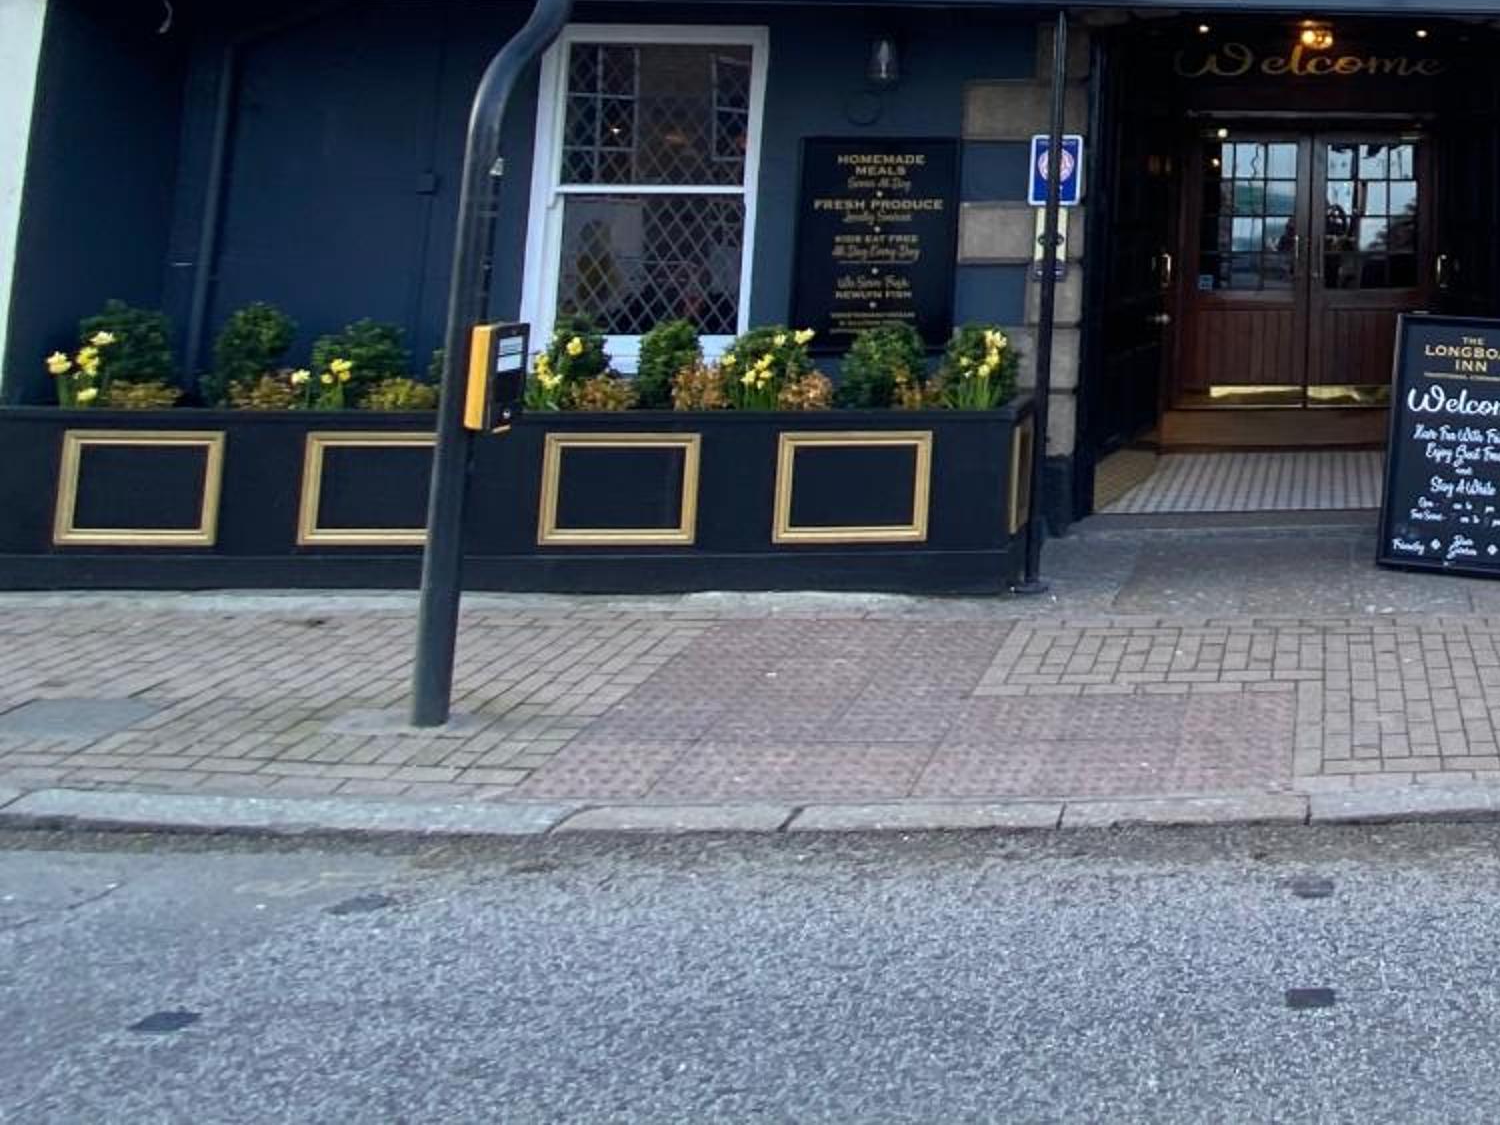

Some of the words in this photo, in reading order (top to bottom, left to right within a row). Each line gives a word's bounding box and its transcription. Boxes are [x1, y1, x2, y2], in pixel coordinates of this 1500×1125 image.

[1173, 43, 1446, 76] Welcome
[837, 154, 926, 165] HOMEMADE
[855, 165, 907, 176] MEALS
[813, 198, 865, 210] FRESH
[870, 198, 944, 210] PRODUCE
[1462, 336, 1485, 345] THE
[1455, 359, 1487, 372] INN
